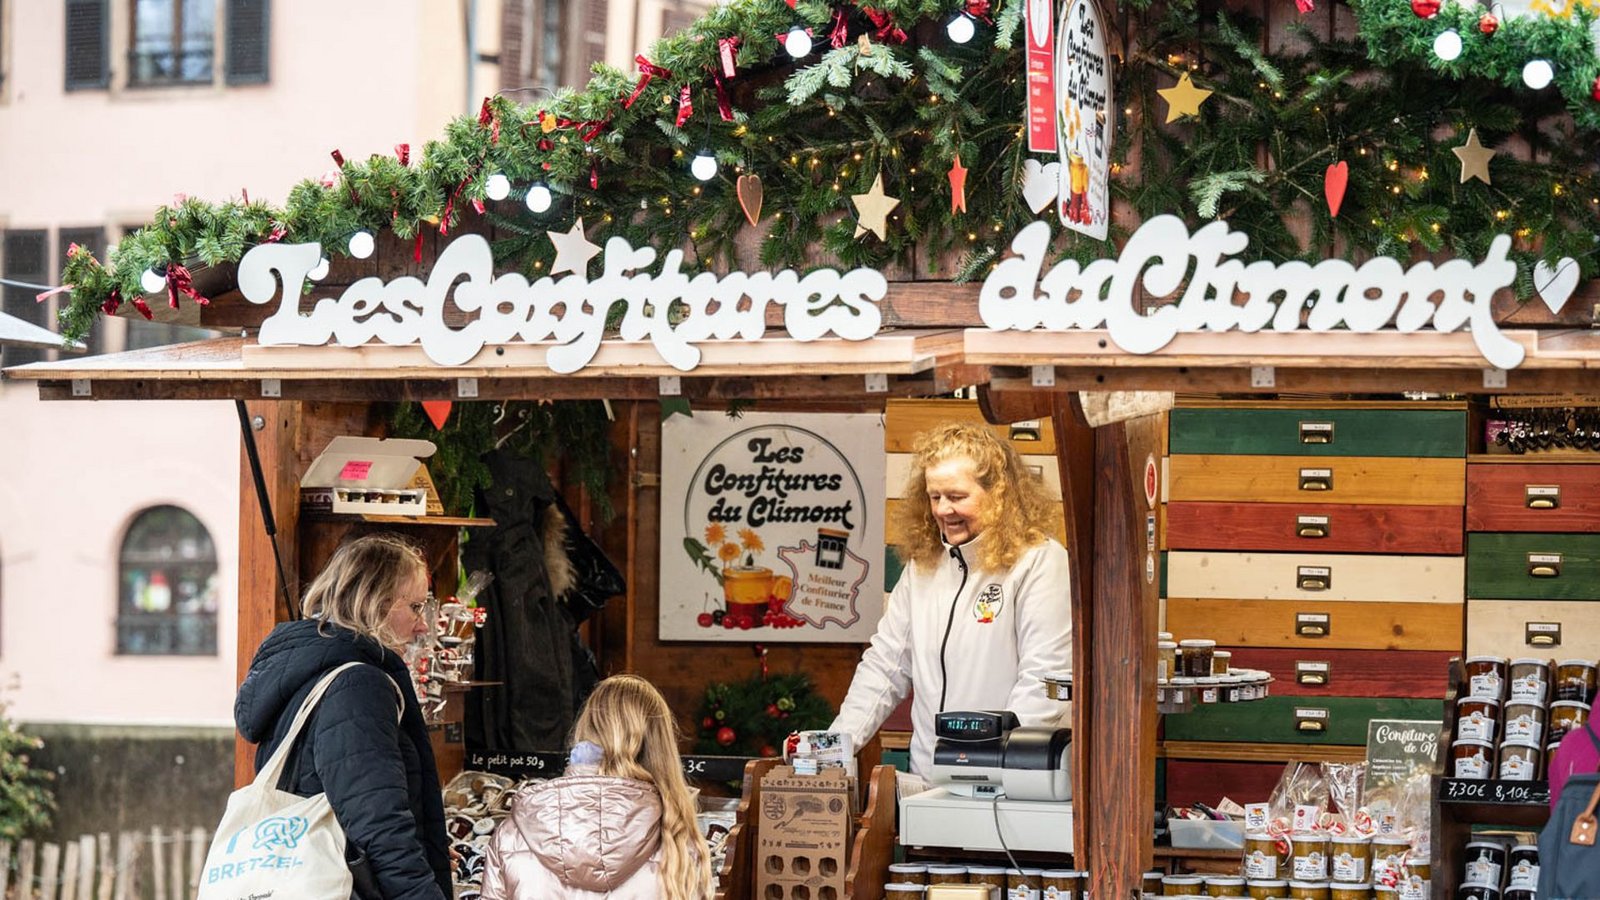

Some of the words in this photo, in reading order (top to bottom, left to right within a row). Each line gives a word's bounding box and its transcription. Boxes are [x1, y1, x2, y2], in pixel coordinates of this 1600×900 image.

[978, 221, 1117, 332] du
[1108, 213, 1526, 370] Climont
[237, 241, 425, 347] Les
[420, 233, 888, 374] Confitures
[747, 437, 805, 464] Les
[704, 463, 843, 498] Confitures
[707, 497, 743, 523] du
[746, 495, 855, 530] Climont
[807, 572, 847, 588] Meilleur
[799, 584, 852, 601] Confiturier
[801, 596, 813, 606] de
[815, 598, 846, 612] France
[1376, 724, 1437, 745] Confiture
[1404, 743, 1417, 754] de
[472, 753, 483, 765] Le
[487, 753, 508, 770] petit
[510, 757, 525, 768] pot
[1447, 781, 1487, 798] 7,30€
[1495, 784, 1531, 802] 8,10€
